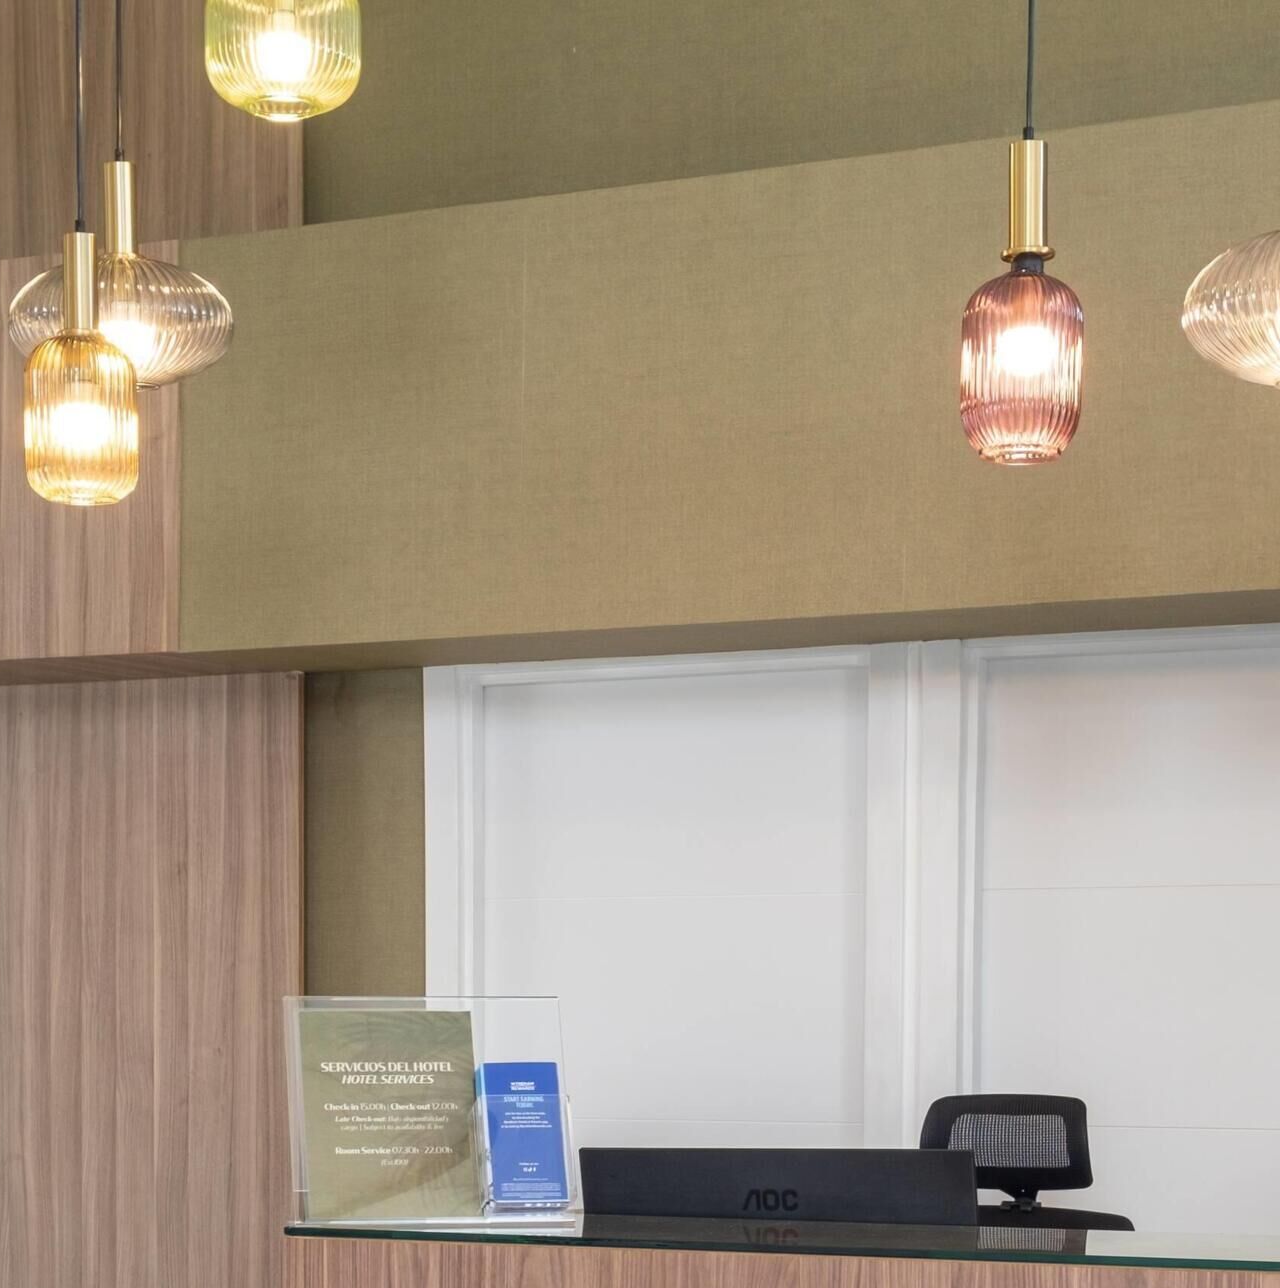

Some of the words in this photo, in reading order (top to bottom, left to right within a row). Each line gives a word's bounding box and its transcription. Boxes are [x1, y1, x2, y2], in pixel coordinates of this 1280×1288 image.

[320, 1061, 387, 1073] SERVICIOS
[387, 1061, 412, 1073] DEL
[412, 1061, 456, 1073] HOTEL
[341, 1074, 380, 1085] HOTEL
[380, 1074, 435, 1085] SERVICES
[742, 1188, 799, 1211] AOC
